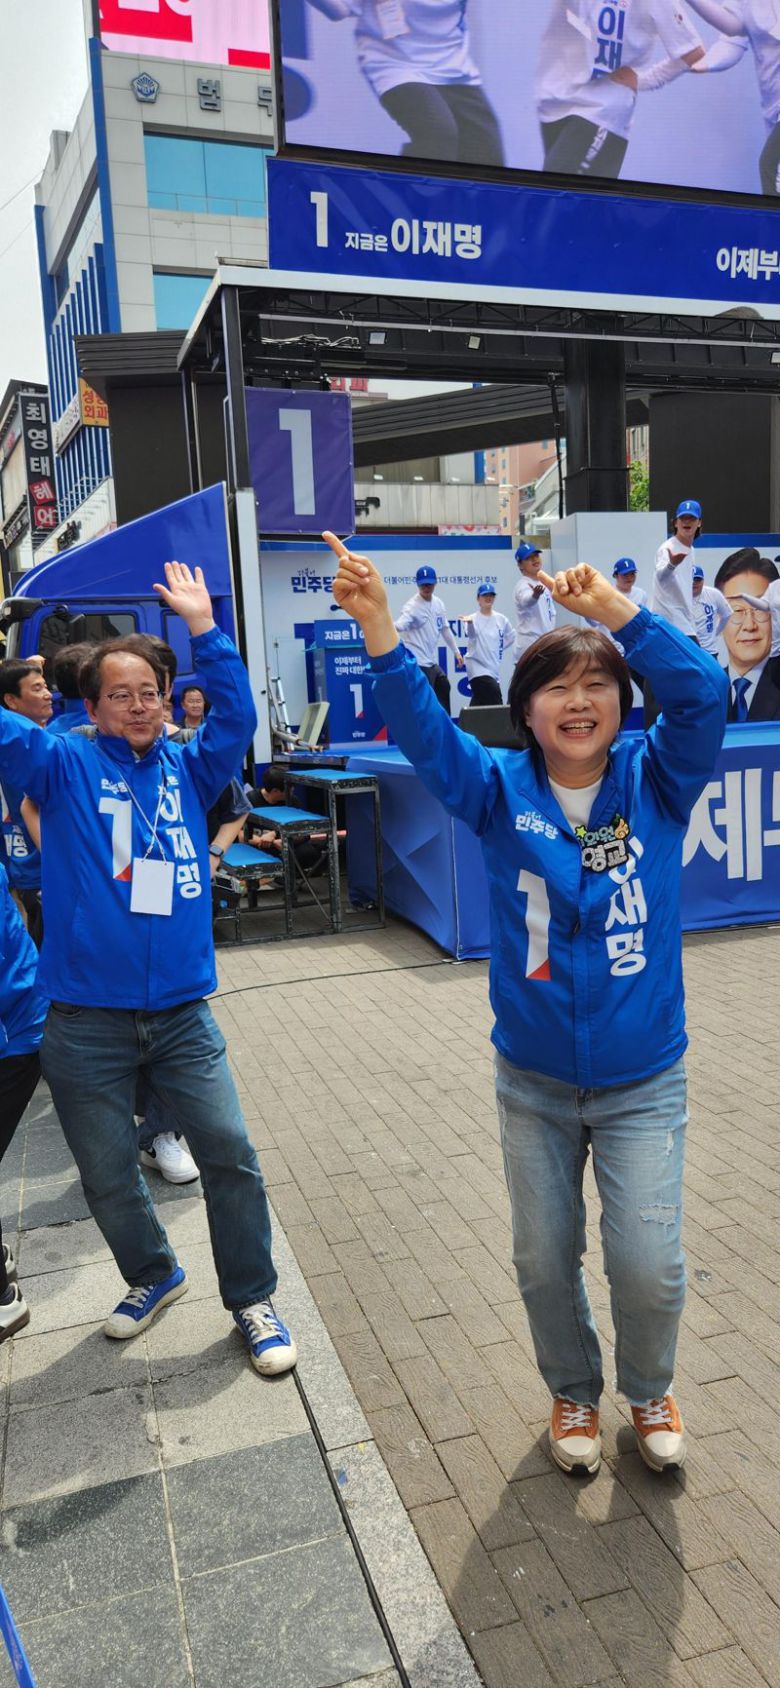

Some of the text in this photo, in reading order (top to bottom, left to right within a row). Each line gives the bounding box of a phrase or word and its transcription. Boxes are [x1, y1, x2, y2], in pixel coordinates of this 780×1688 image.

[310, 191, 482, 260] 1 지금은 이재명
[716, 246, 780, 281] 이제부
[26, 403, 50, 477] 최영태
[84, 405, 107, 419] 외과
[279, 408, 315, 516] 1
[449, 575, 484, 585] 대통령선거
[485, 575, 497, 584] 후보
[324, 631, 350, 641] 지금은
[350, 623, 357, 640] 1
[350, 683, 365, 718] 1
[98, 797, 132, 882] 1
[160, 788, 202, 899] 이재명
[515, 814, 559, 840] 민주당
[517, 868, 551, 981] 1
[605, 836, 648, 977] 이재명
